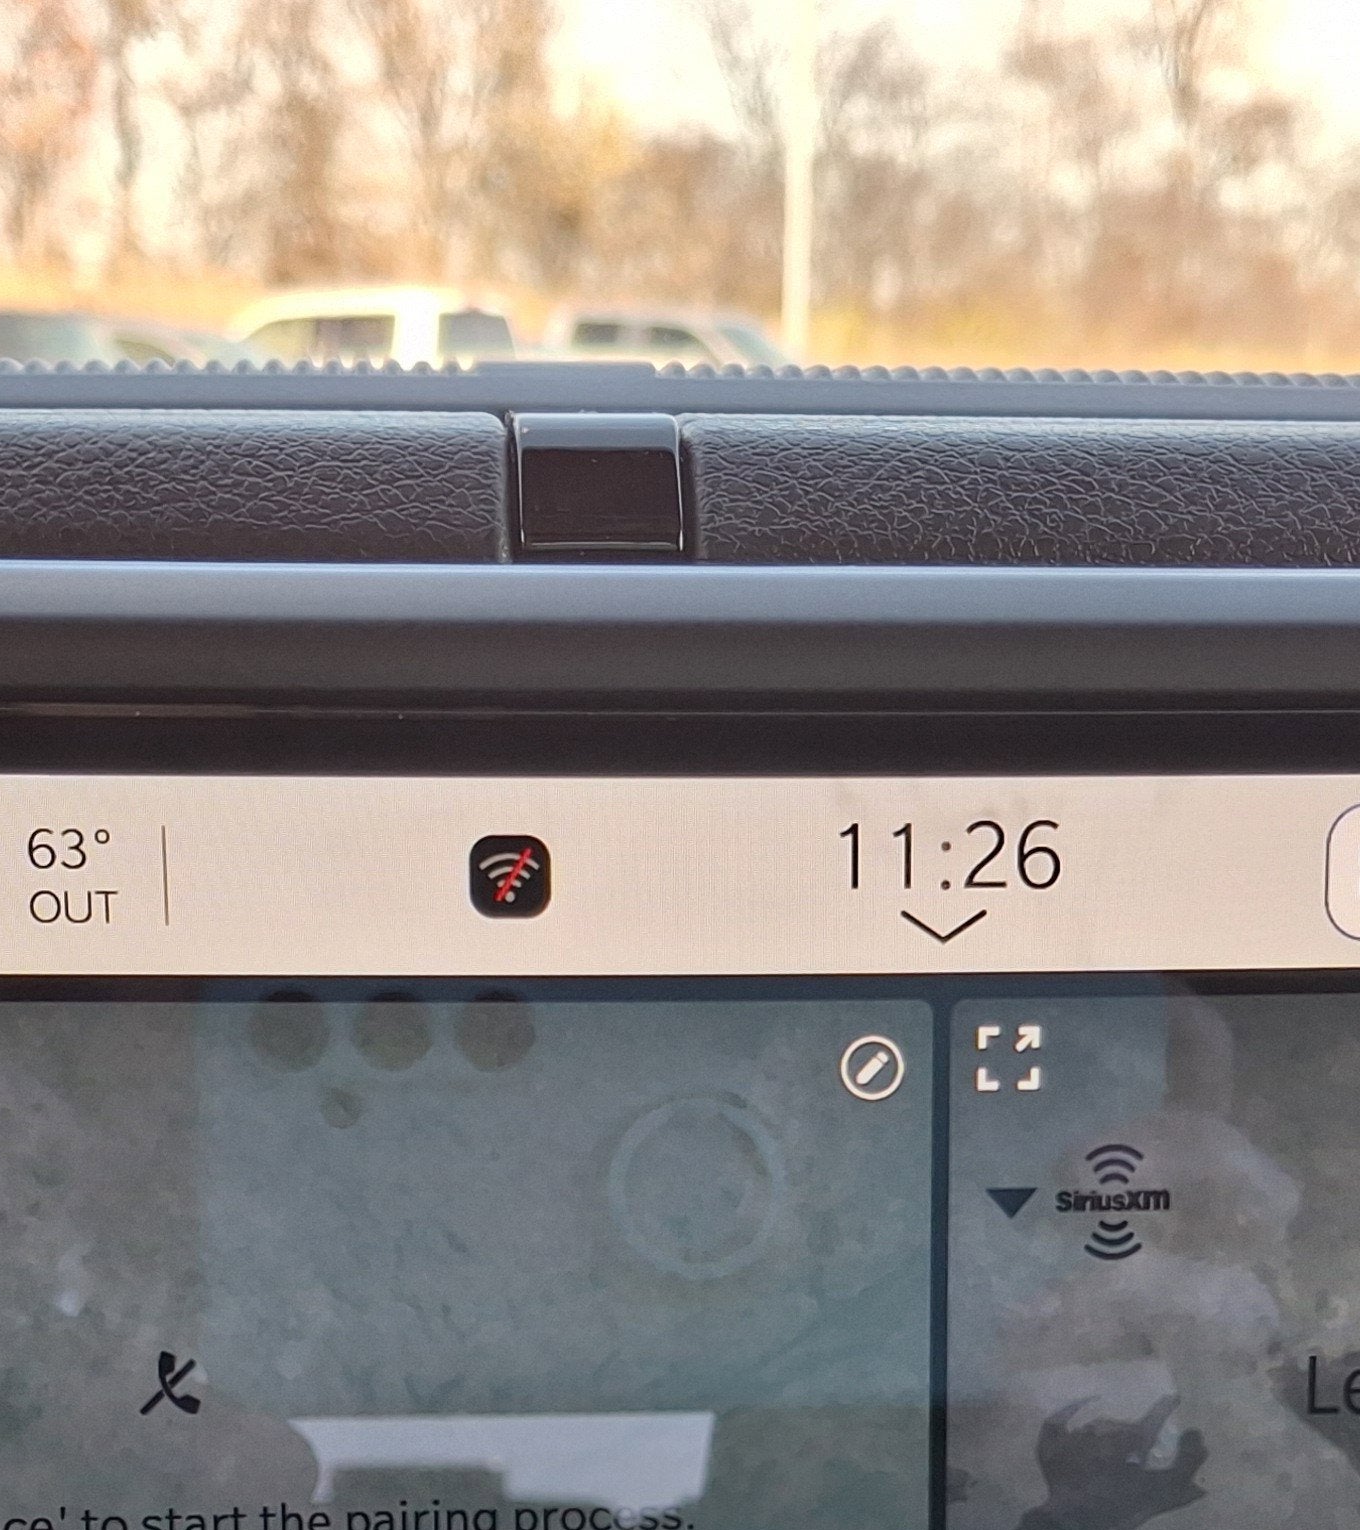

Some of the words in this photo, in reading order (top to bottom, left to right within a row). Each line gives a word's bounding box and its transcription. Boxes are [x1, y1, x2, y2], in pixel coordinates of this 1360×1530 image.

[26, 827, 111, 870] 63°
[838, 819, 1062, 889] 11:26
[28, 889, 119, 924] OUT
